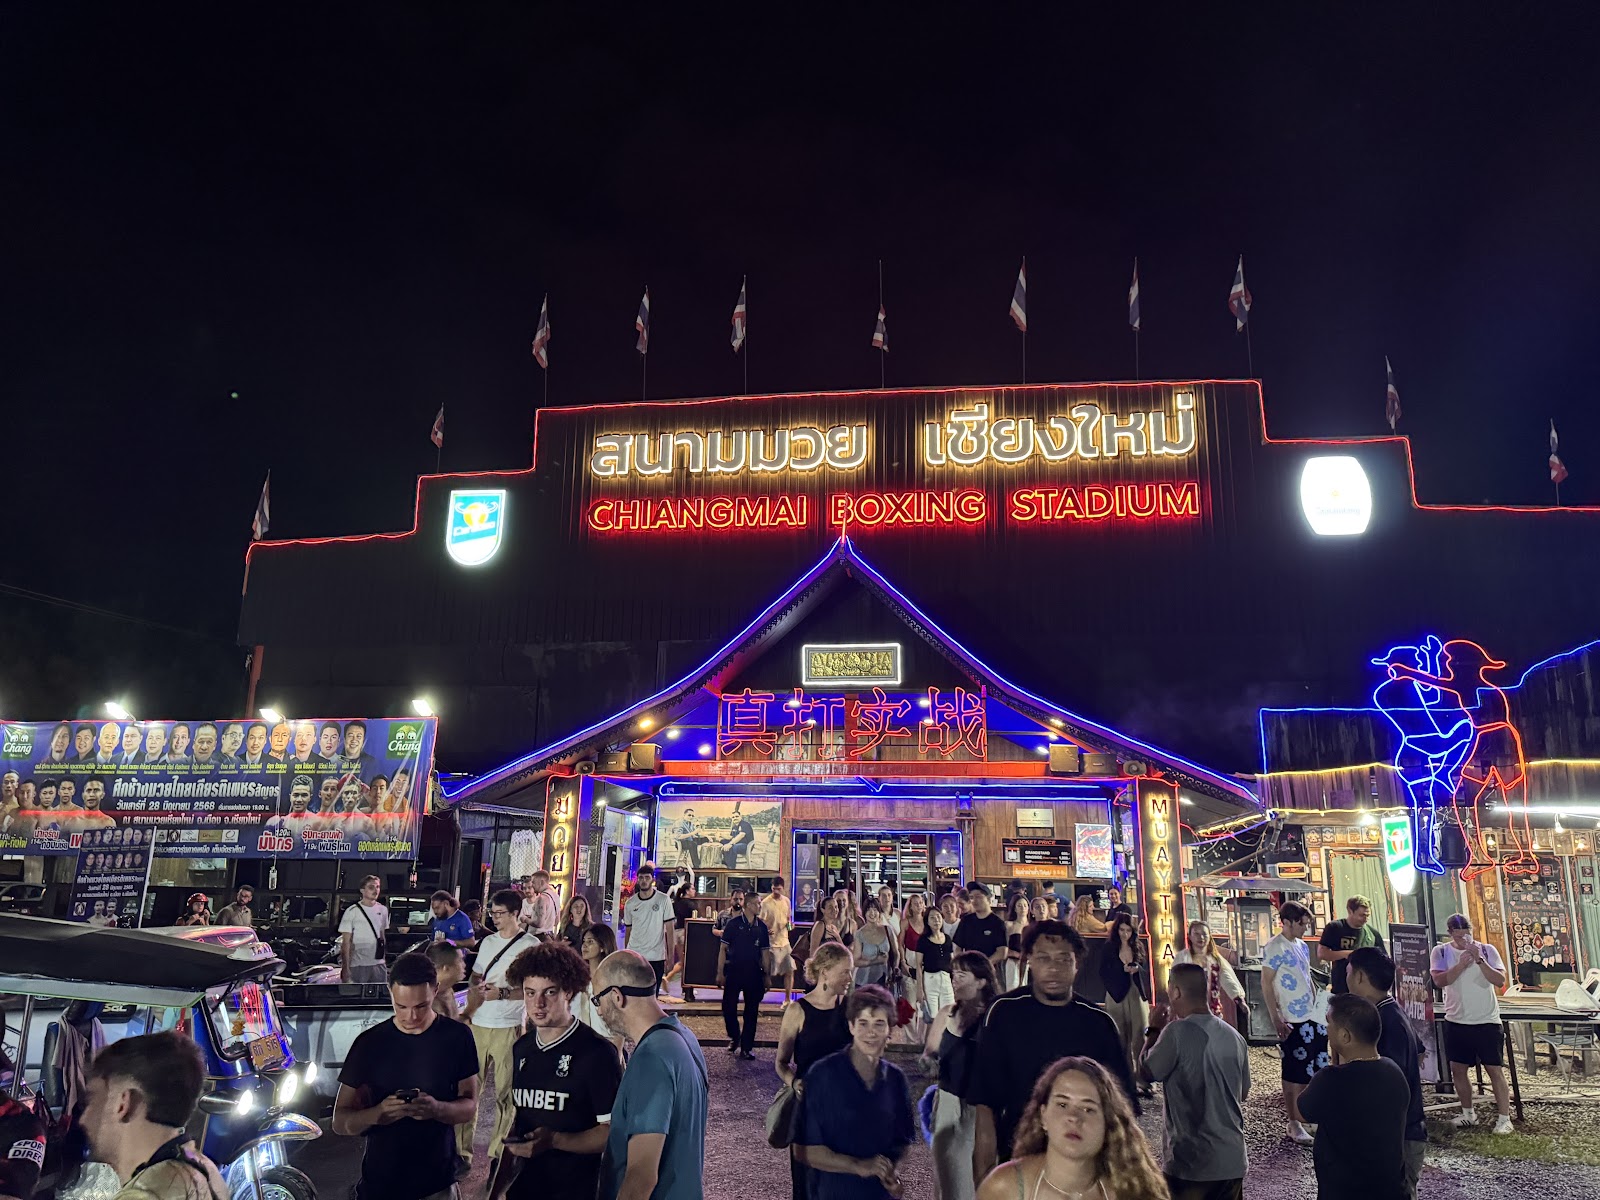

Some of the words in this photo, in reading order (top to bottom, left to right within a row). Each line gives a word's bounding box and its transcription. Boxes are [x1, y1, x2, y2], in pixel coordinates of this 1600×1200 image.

[591, 425, 867, 476] สนามมวย
[924, 392, 1195, 466] เชียงใหม่
[589, 496, 807, 531] CHIANGMAI
[831, 490, 986, 525] BOXING
[1011, 483, 1200, 521] STADIUM
[717, 686, 987, 758] 真打实战
[3, 743, 32, 754] Chang
[388, 740, 421, 753] Chang
[148, 801, 160, 811] 28
[193, 801, 216, 811] 2568
